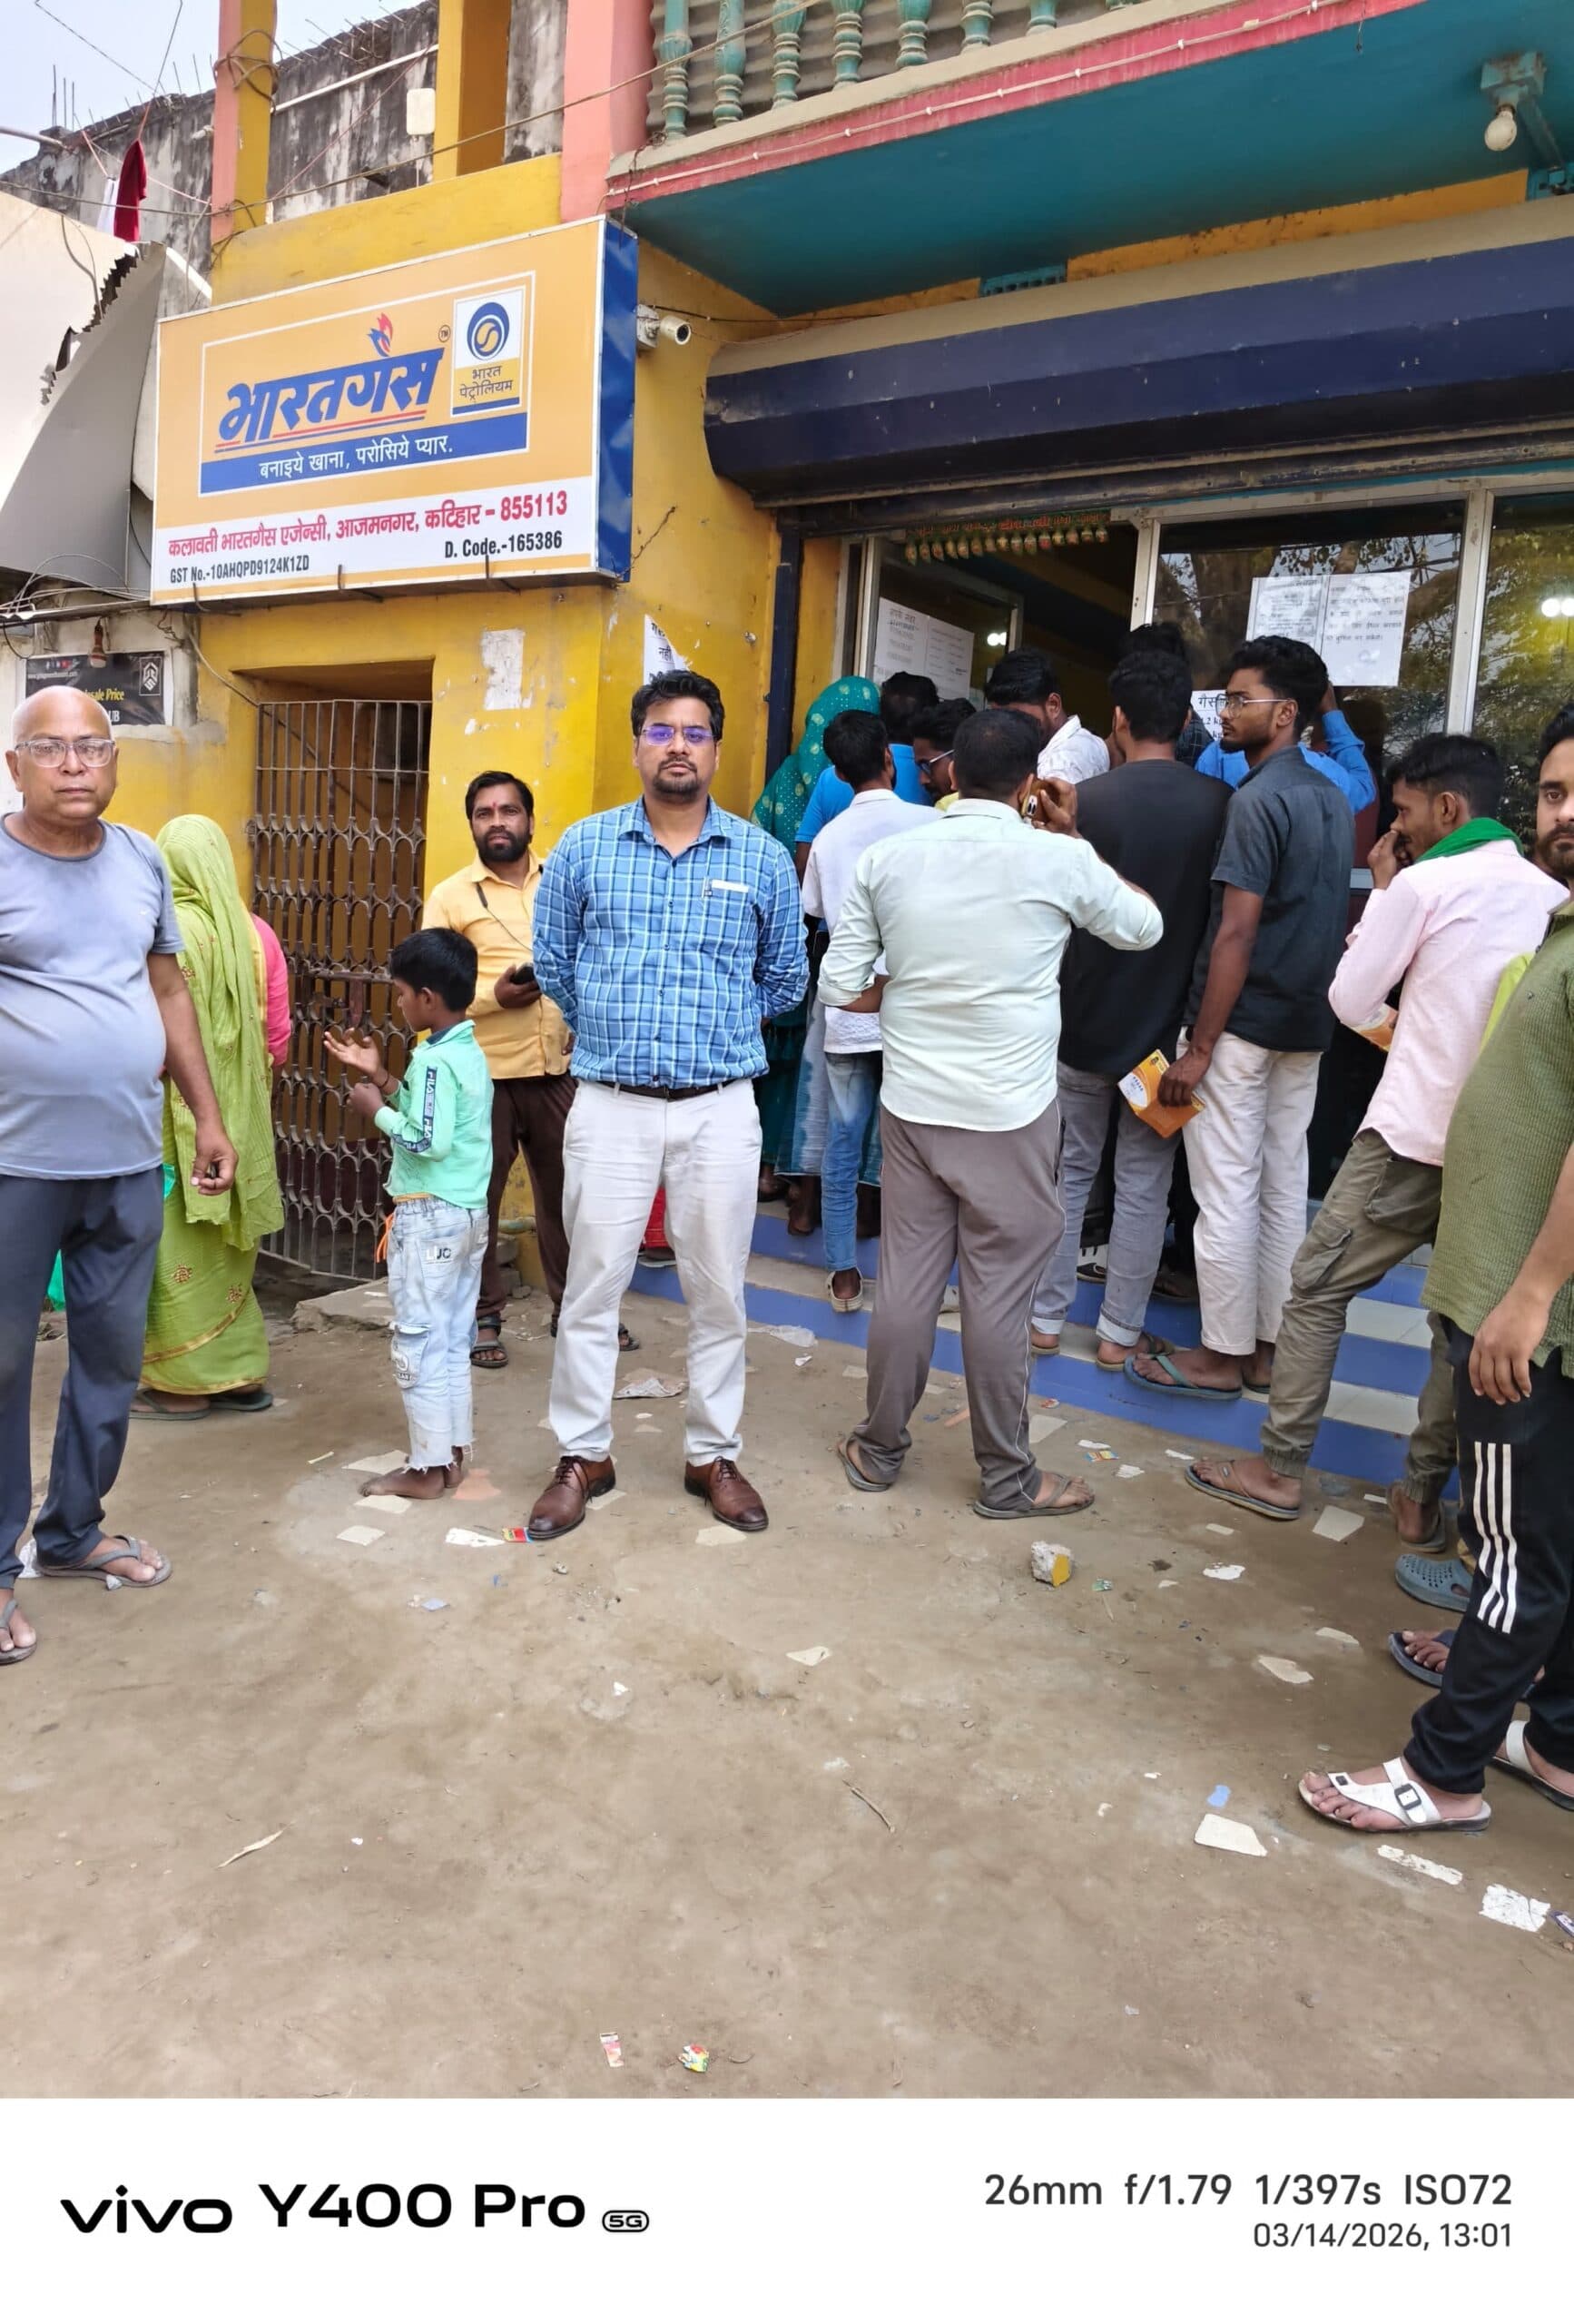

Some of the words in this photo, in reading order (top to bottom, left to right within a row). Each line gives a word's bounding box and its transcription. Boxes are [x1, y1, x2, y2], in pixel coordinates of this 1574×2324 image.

[472, 365, 502, 379] भारत
[459, 379, 513, 400] पेट्रोलियम
[259, 451, 304, 478] बनाइये
[309, 450, 350, 471] खाना,
[356, 435, 409, 465] परोसिये
[415, 435, 453, 456] प्यार.
[168, 527, 219, 556] कलावती
[221, 521, 278, 551] भारतगैस
[280, 514, 331, 546] एजेन्सी,
[335, 511, 419, 539] आजमनगर,
[424, 498, 482, 529] कटिहार
[500, 490, 567, 521] 855113
[445, 540, 457, 558] D.
[462, 530, 563, 557] Code.-165386
[170, 566, 188, 584] GST
[105, 687, 125, 701] Price
